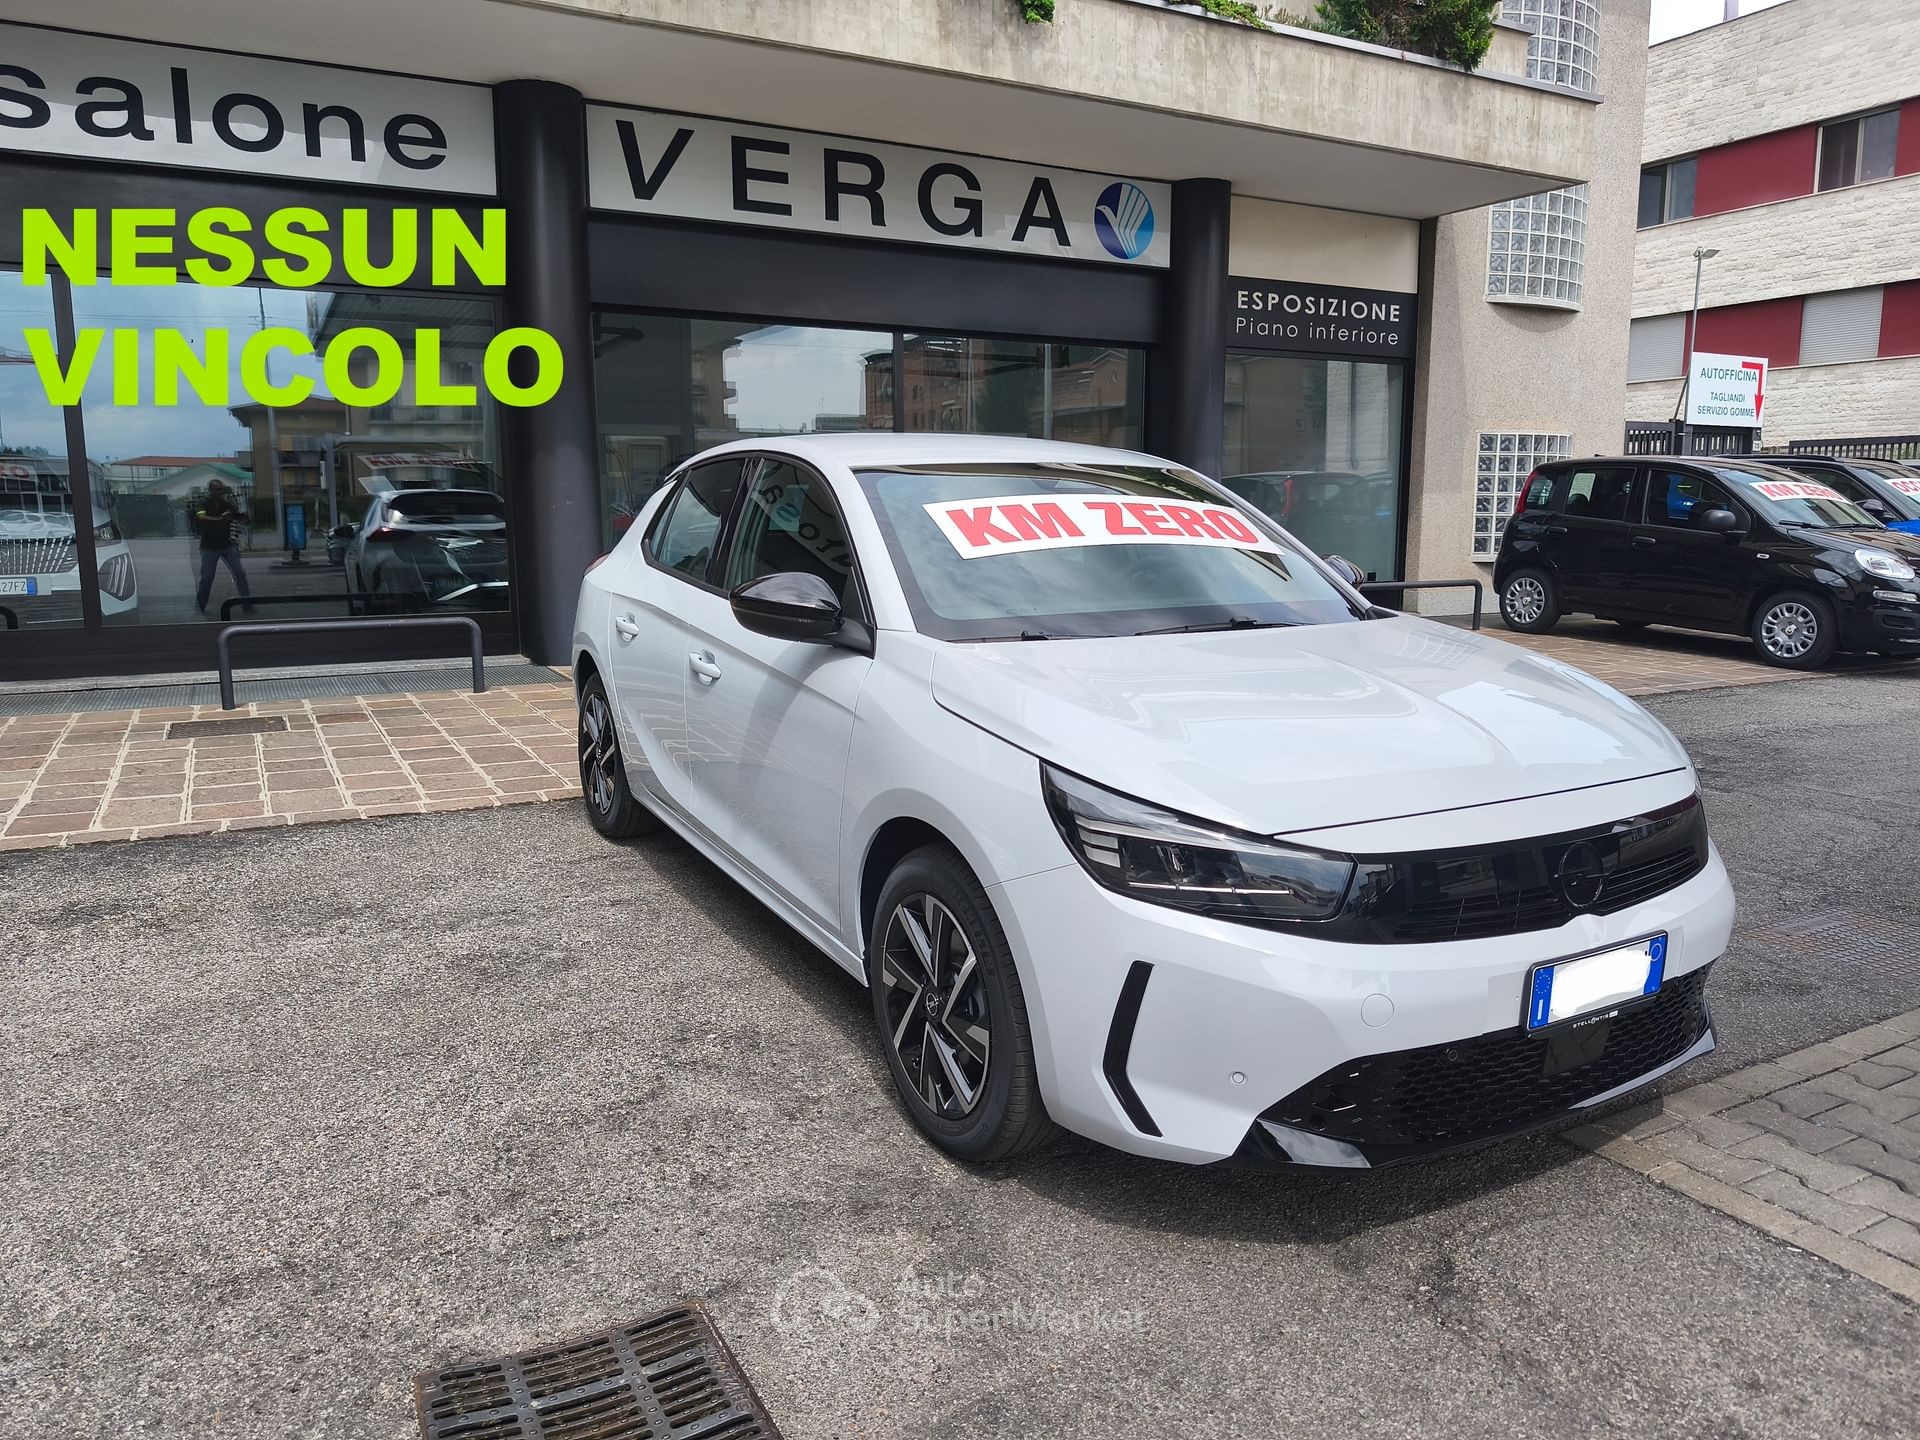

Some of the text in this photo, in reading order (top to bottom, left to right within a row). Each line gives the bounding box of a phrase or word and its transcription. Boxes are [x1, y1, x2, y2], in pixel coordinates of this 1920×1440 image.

[0, 65, 449, 170] salone
[615, 119, 1071, 247] VERGA
[1237, 290, 1400, 323] ESPOSIZIONE
[1235, 317, 1399, 345] Piano inferiore
[1700, 367, 1757, 382] AUTOFFICINA
[1710, 391, 1746, 403] TAGLIANDI
[1697, 405, 1755, 418] SERVIZIO GOMME
[1758, 483, 1800, 497] KM
[1892, 480, 1920, 492] OCC
[945, 501, 1260, 548] KM ZERO
[0, 581, 26, 593] 27FZ
